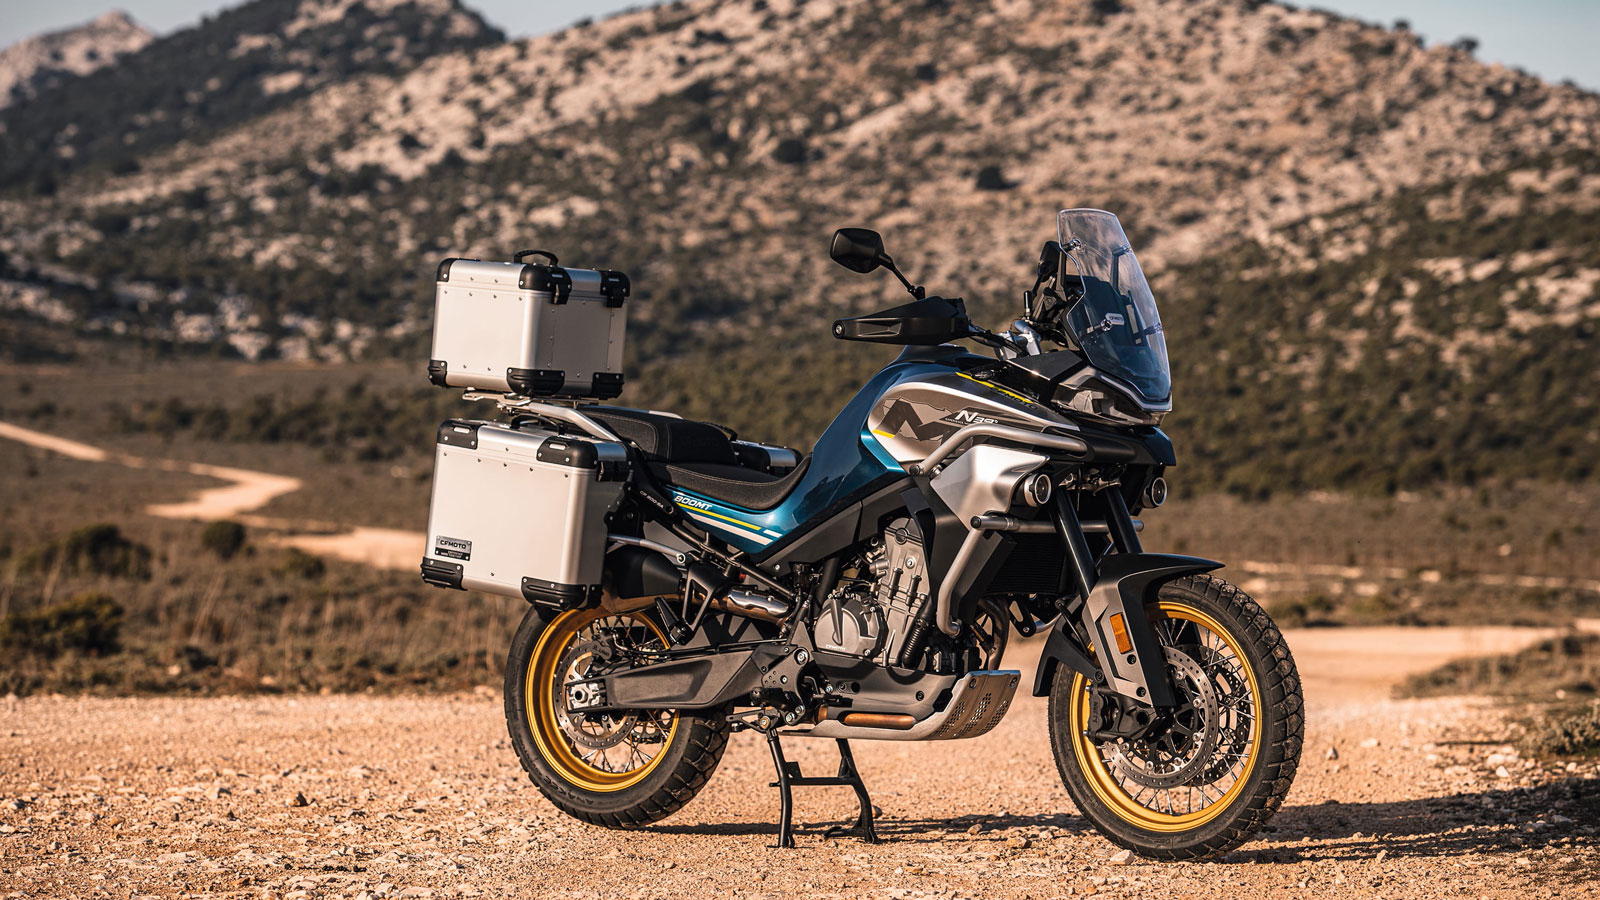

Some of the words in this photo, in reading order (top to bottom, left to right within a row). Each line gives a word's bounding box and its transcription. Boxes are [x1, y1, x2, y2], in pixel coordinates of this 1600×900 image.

[674, 495, 713, 511] 800MT
[440, 540, 467, 549] CFMOTO
[543, 775, 594, 806] ANAKEE
